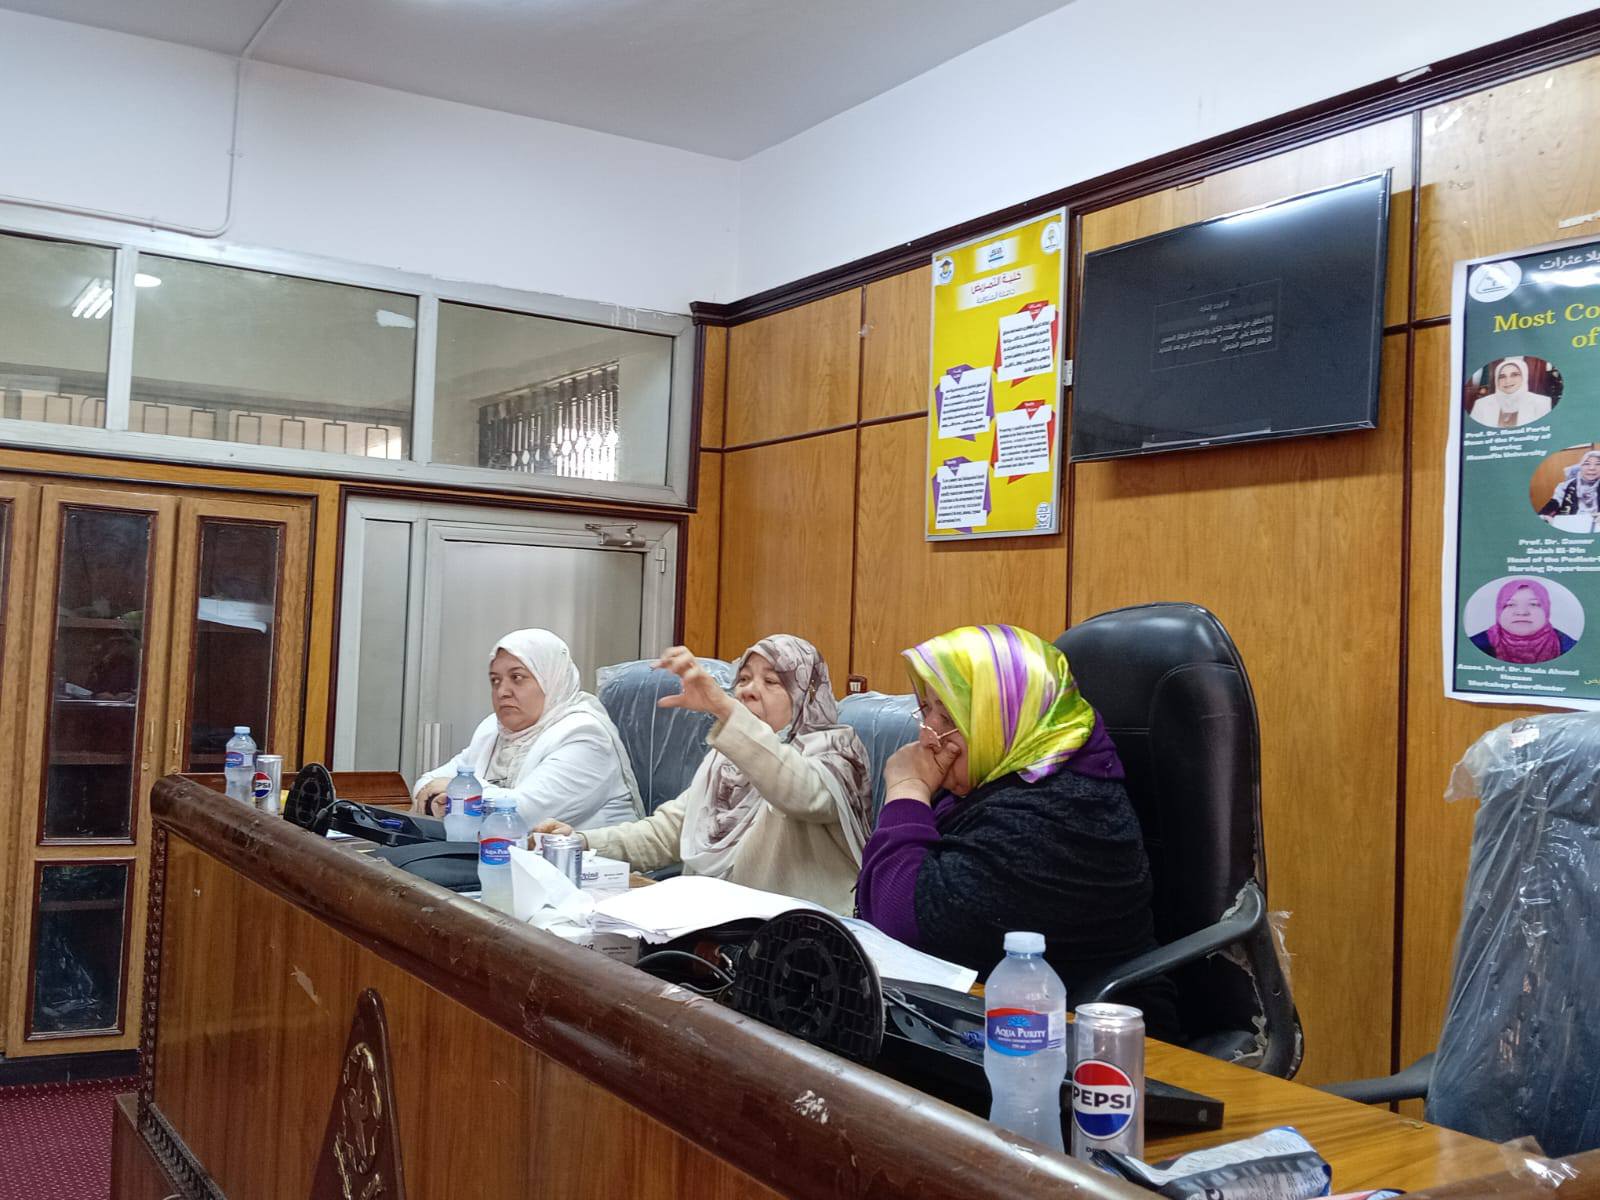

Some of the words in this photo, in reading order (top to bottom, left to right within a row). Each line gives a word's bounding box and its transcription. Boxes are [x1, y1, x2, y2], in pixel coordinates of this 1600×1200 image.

[1539, 254, 1583, 270] عثرات
[1493, 310, 1557, 333] Most
[1571, 326, 1600, 348] of
[1073, 1085, 1132, 1110] PEPSI
